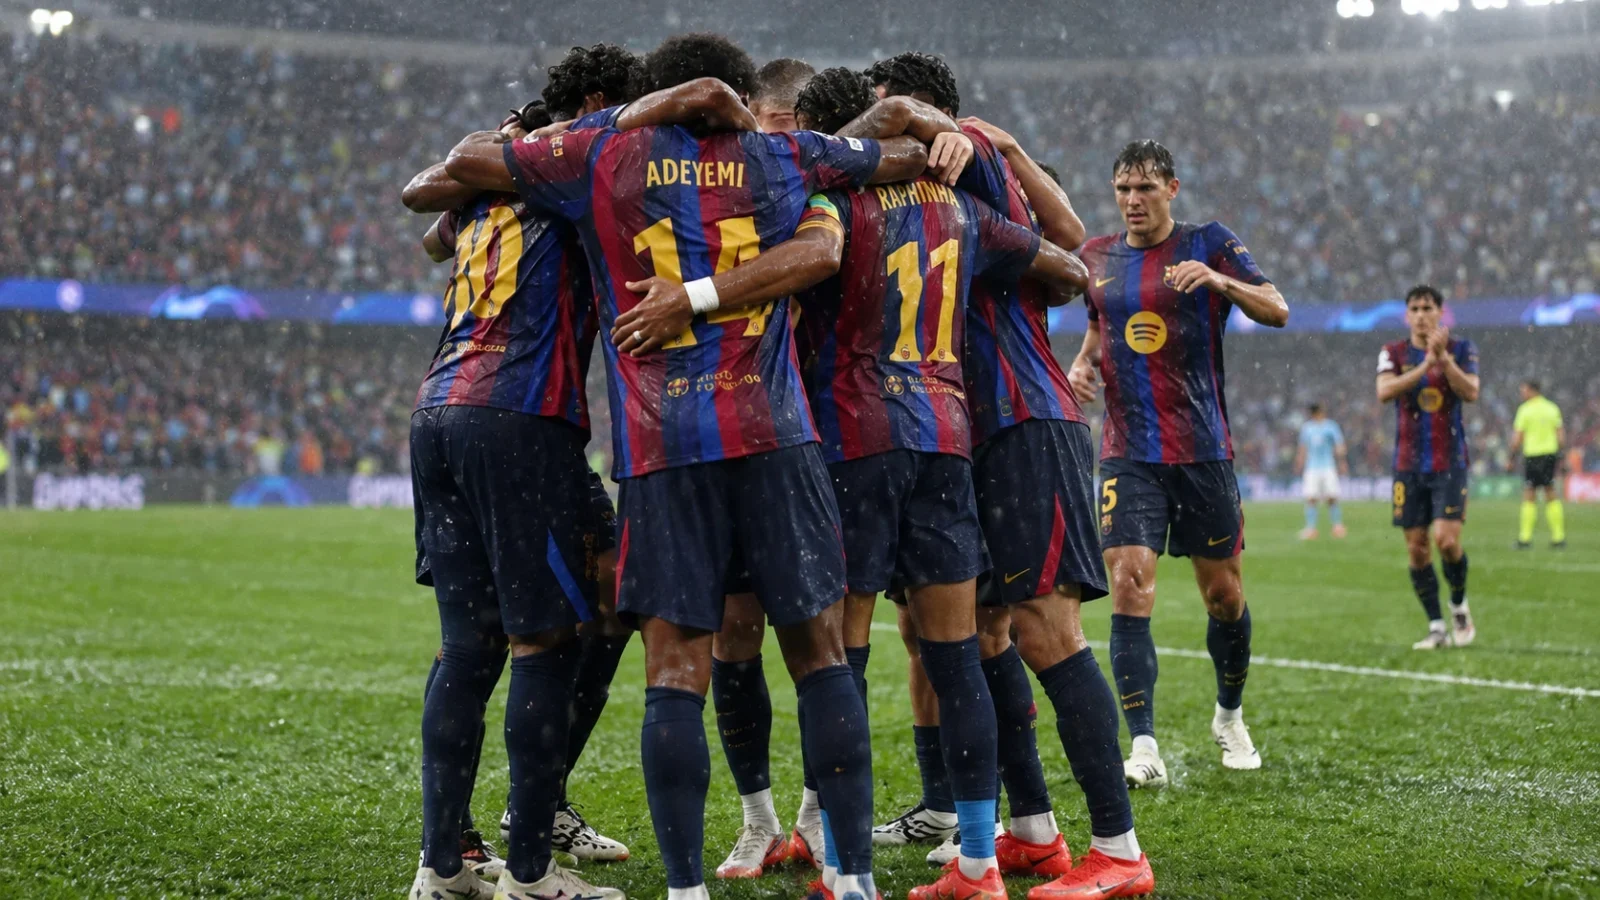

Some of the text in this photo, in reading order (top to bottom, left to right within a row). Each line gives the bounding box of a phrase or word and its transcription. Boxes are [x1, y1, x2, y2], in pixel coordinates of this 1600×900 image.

[646, 158, 744, 188] ADEYEMI
[876, 181, 961, 211] RAPHINHA
[443, 205, 523, 331] 10
[633, 215, 773, 349] 14
[887, 238, 958, 362] 11
[1102, 477, 1118, 513] 5
[1393, 481, 1406, 507] 8
